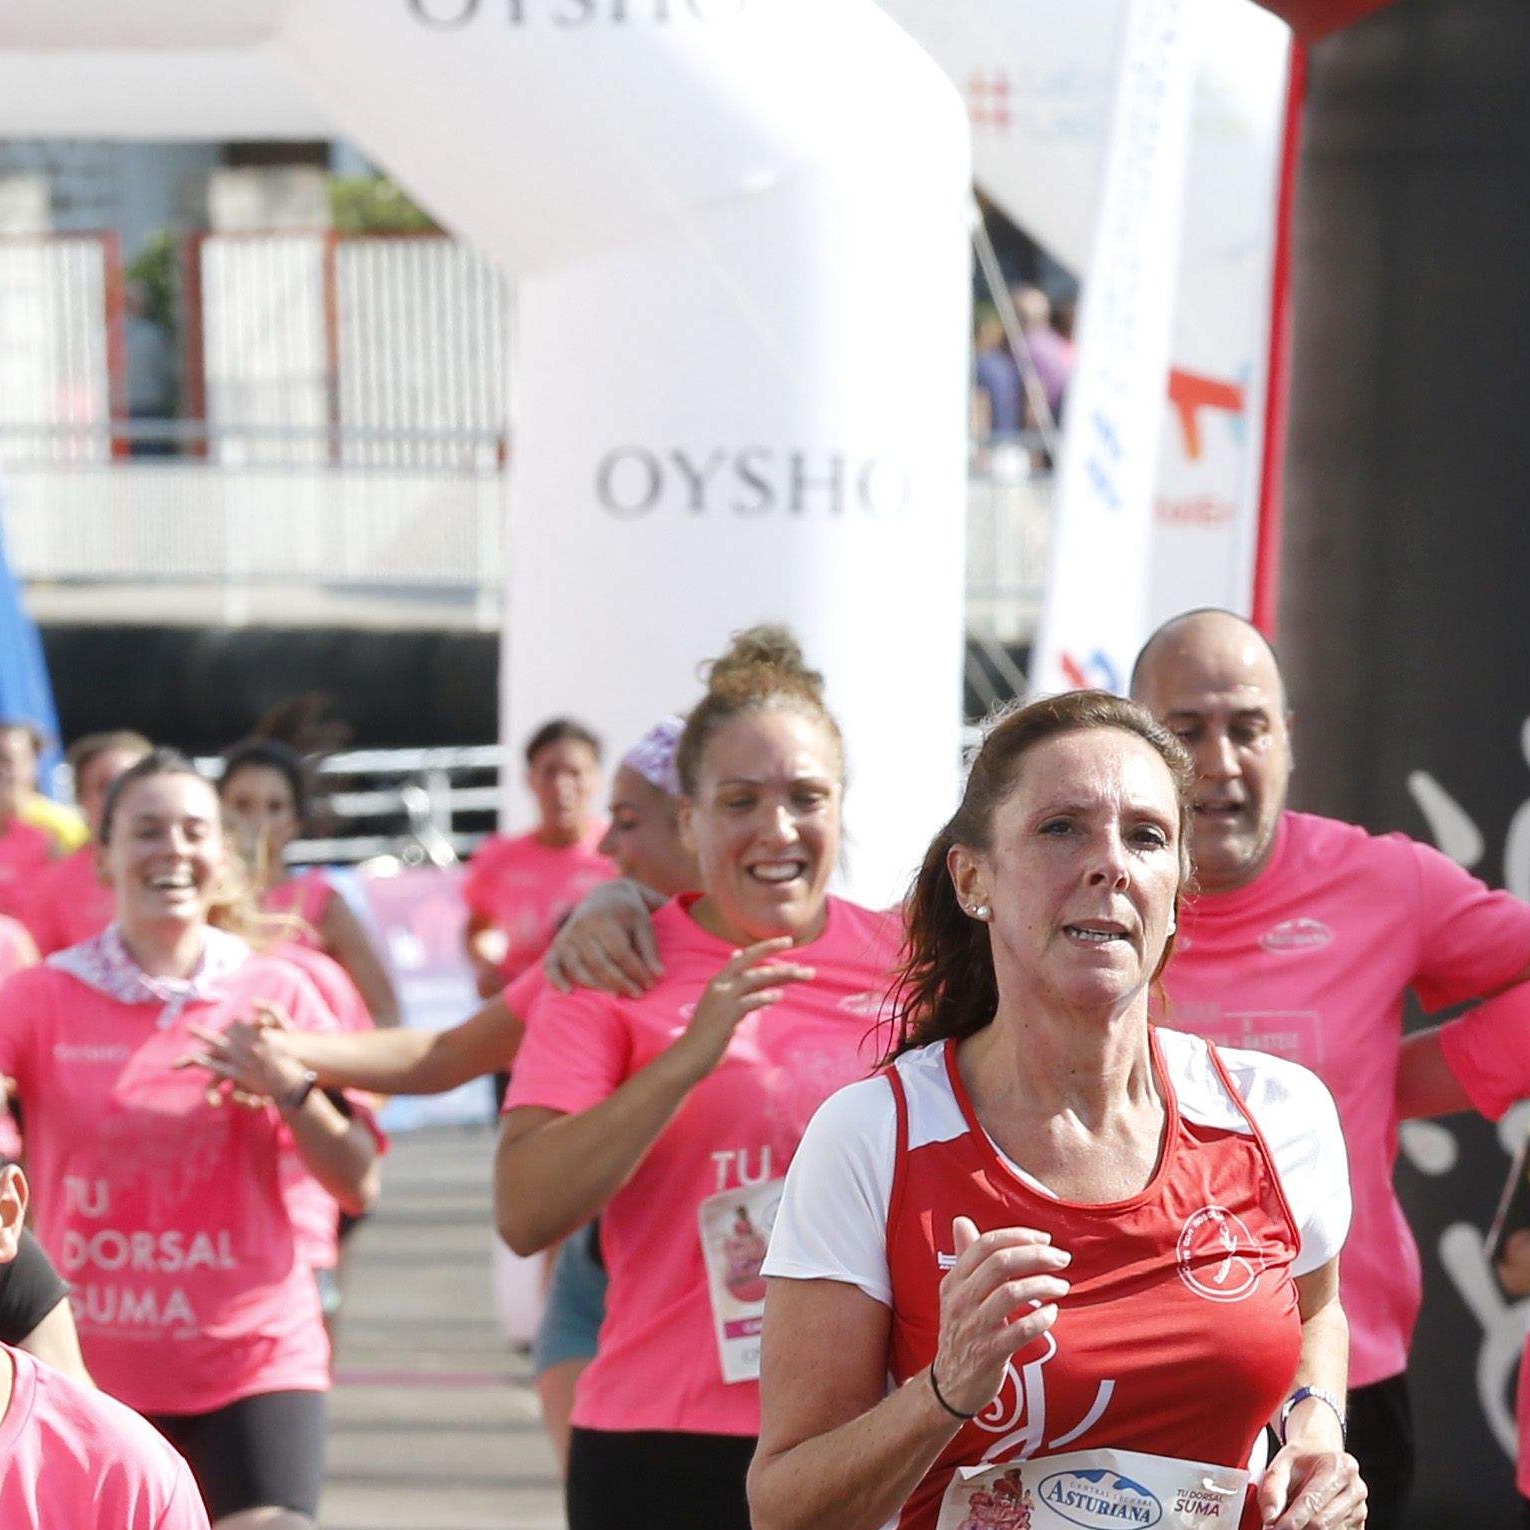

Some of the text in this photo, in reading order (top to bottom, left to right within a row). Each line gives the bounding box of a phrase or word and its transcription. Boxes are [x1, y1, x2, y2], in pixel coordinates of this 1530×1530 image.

[594, 443, 911, 521] OYSHO
[711, 1147, 770, 1190] TU
[63, 1175, 110, 1218] TU
[61, 1229, 239, 1272] DORSAL
[67, 1284, 199, 1323] SUMA
[1046, 1480, 1151, 1524] ASTURIANA
[1174, 1498, 1220, 1517] SUMA
[1188, 1490, 1224, 1502] DORSAL
